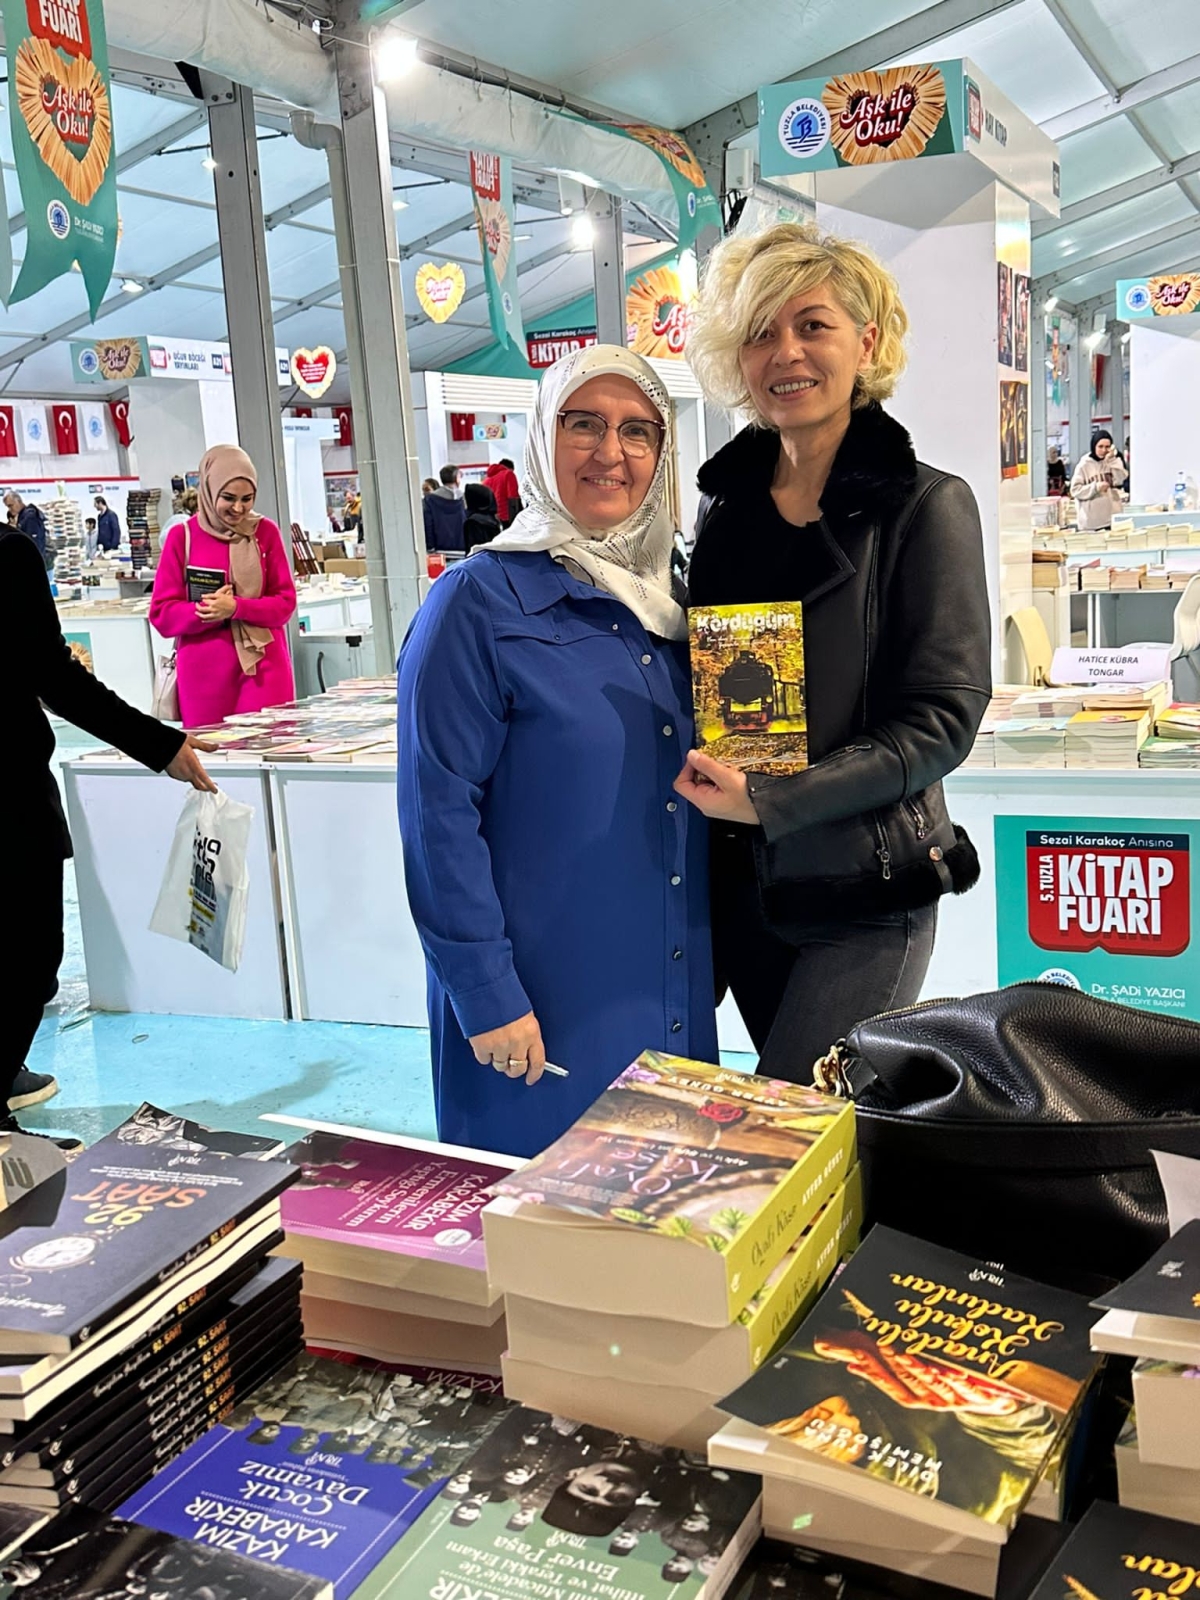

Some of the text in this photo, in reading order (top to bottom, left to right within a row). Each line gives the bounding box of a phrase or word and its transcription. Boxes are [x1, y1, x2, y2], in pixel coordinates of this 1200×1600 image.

[38, 0, 83, 44] FUARI
[43, 85, 92, 113] Aşk ile
[840, 88, 912, 124] Aşk ile
[57, 110, 88, 137] Oku!
[856, 111, 903, 140] Oku!
[1078, 654, 1139, 664] HATİCE KÜBRA
[1088, 668, 1124, 677] TONGAR
[1039, 834, 1174, 848] Sezai Karakoç Anısına
[1058, 853, 1174, 899] KİTAP
[1058, 895, 1162, 935] FUARI
[1091, 983, 1109, 994] Dr.
[1144, 986, 1185, 999] YAZICI
[399, 1161, 448, 1190] Yaptığı
[71, 1180, 207, 1208] SAAT
[346, 1188, 408, 1227] Soykırım
[375, 1169, 458, 1224] Ermenilerin
[402, 1173, 488, 1231] KARABEKİR
[440, 1187, 492, 1222] KAZIM
[84, 1202, 153, 1226] 92.
[889, 1273, 1065, 1341] Kadınlar
[894, 1299, 1030, 1356] Kokulu
[863, 1316, 1027, 1379] Anadolu
[804, 1425, 861, 1454] TUNA
[238, 1460, 371, 1506] Davamız
[239, 1480, 333, 1516] Çocuk
[184, 1496, 338, 1549] KARABEKİR
[193, 1522, 290, 1561] KAZIM
[494, 1536, 619, 1582] Enver Paşa
